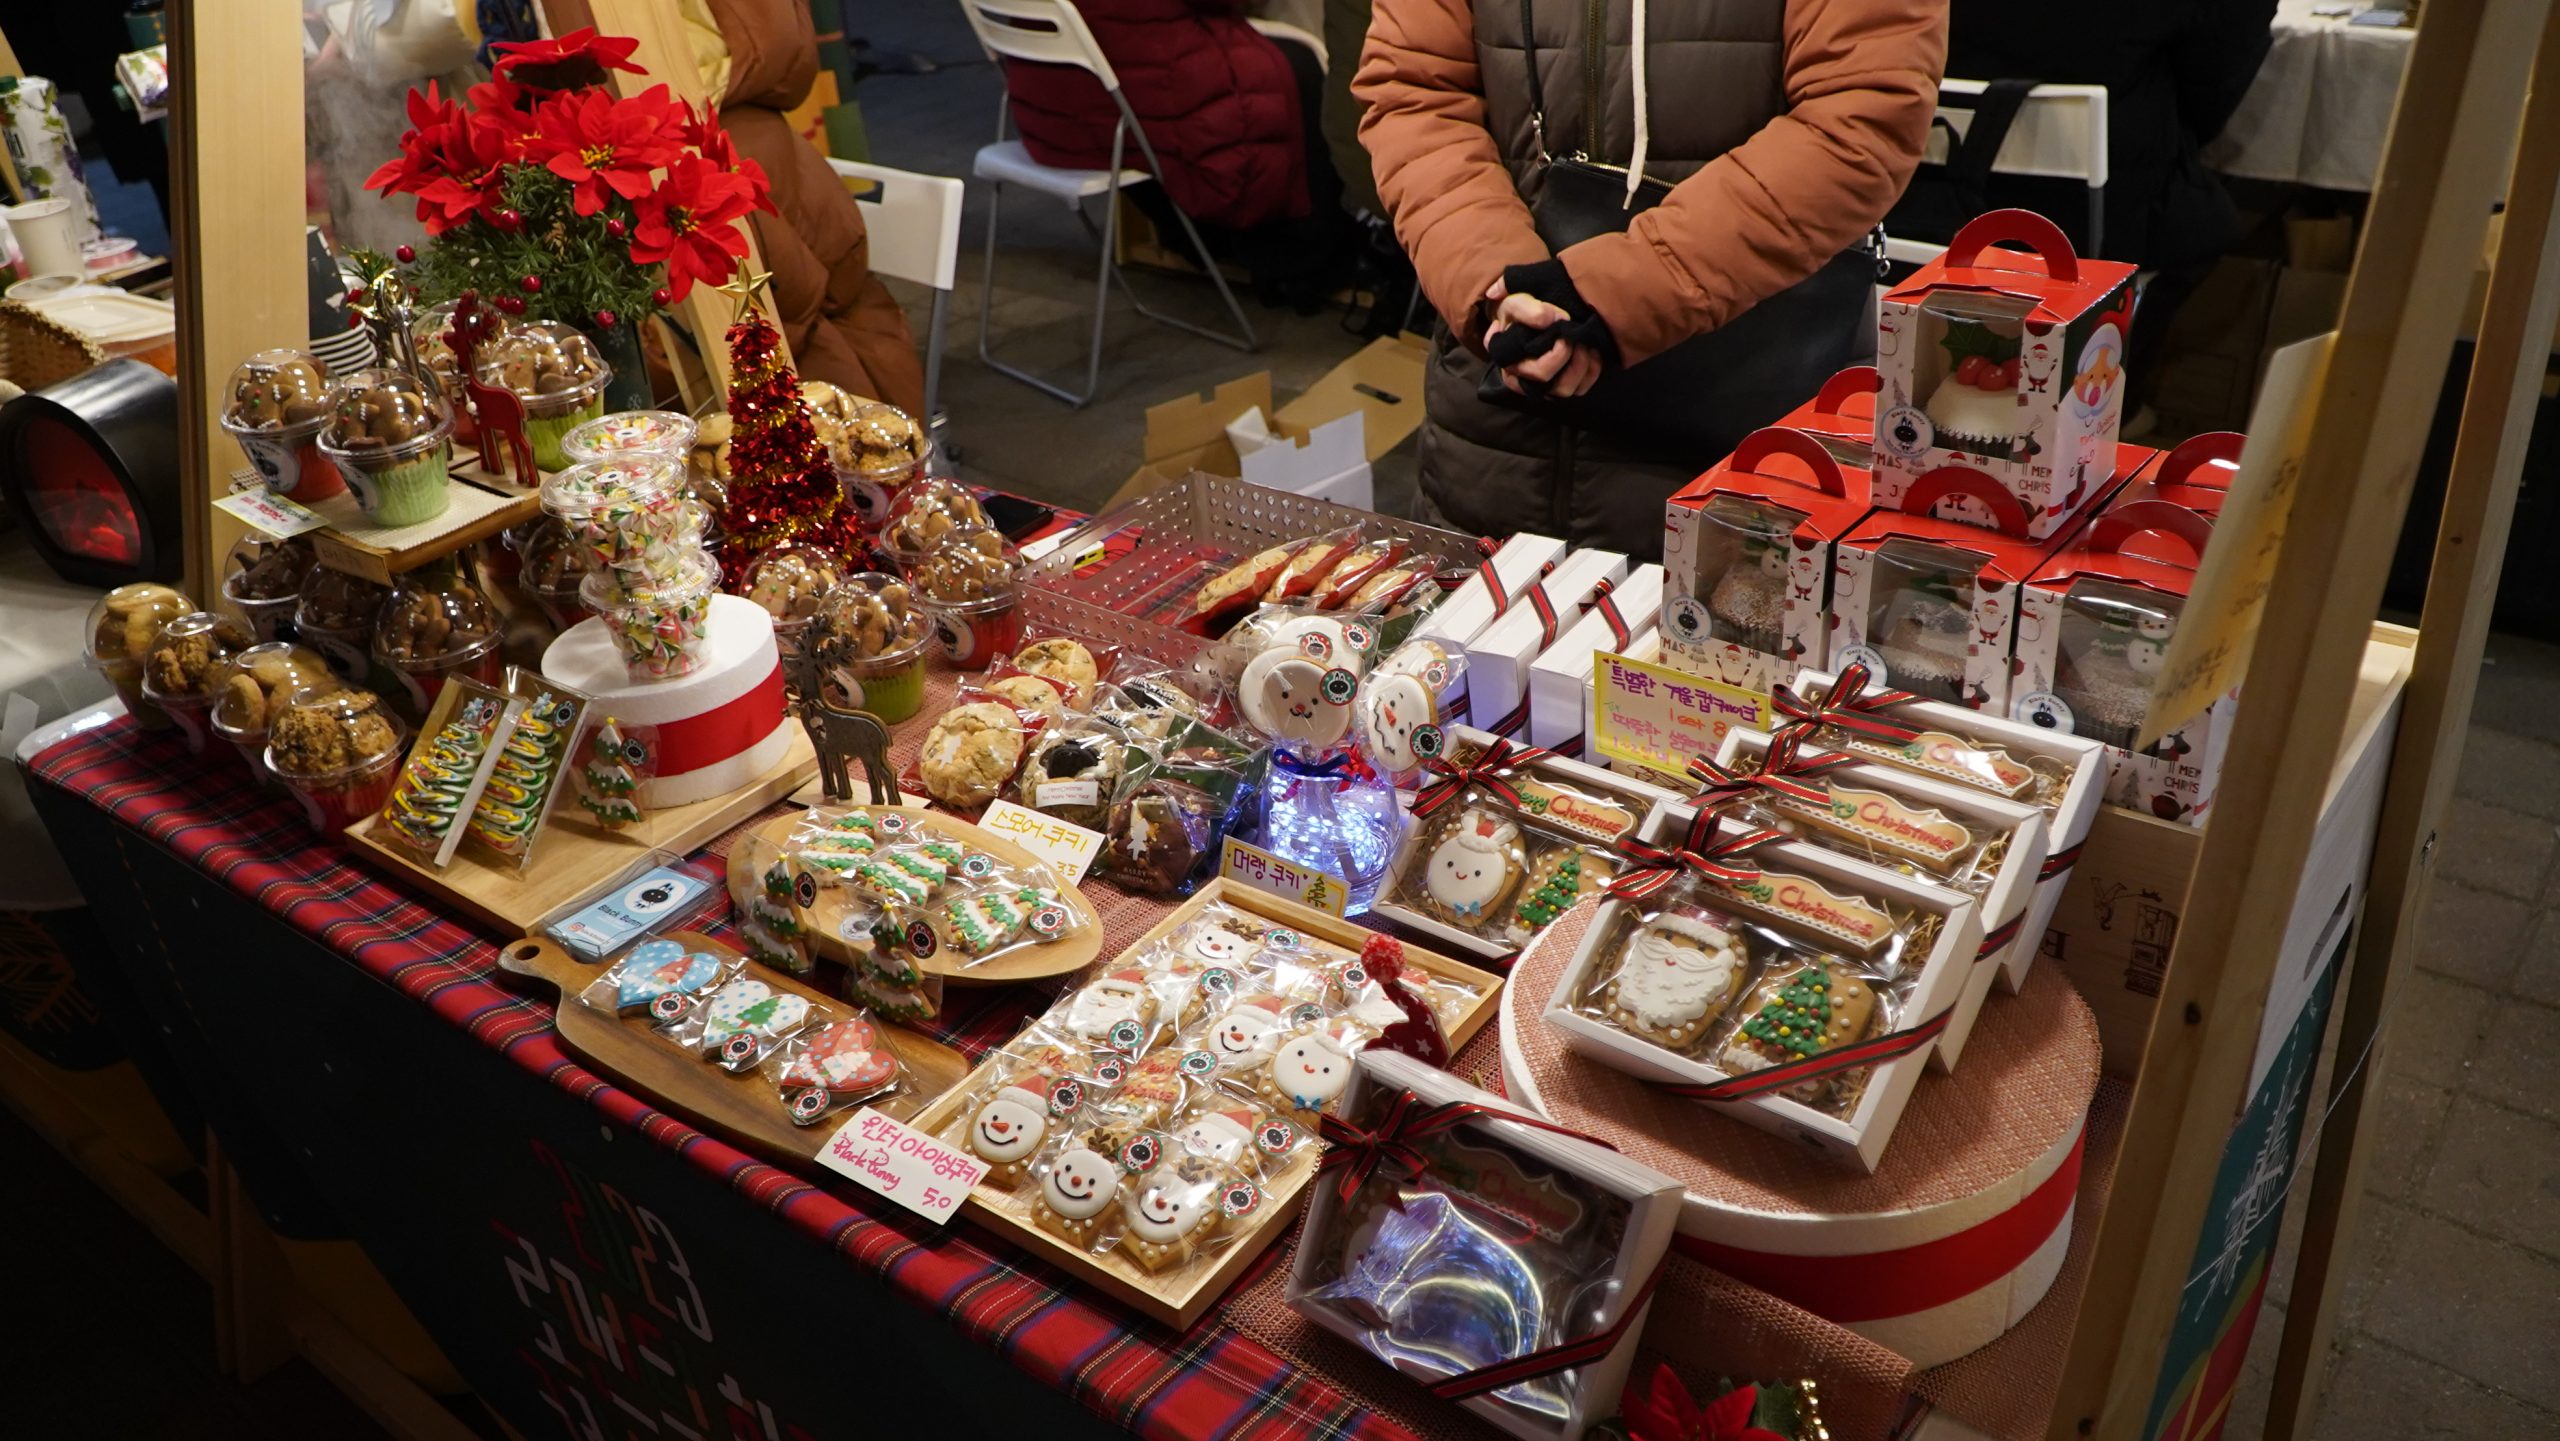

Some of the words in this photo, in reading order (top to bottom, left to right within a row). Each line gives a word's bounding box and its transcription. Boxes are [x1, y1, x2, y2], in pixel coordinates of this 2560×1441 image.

[1611, 664, 1657, 698] 특별한
[990, 808, 1044, 839] 스모어
[1042, 825, 1089, 853] 쿠키
[1549, 794, 1625, 835] Christmas
[1859, 801, 1954, 852] Christmas
[1232, 847, 1266, 881] 머랭
[1269, 863, 1300, 890] 쿠키
[598, 903, 620, 918] Black
[620, 914, 644, 928] Bunny
[1778, 885, 1874, 938] Christmas
[833, 1132, 867, 1169] Black
[867, 1148, 902, 1192] Bunny
[922, 1187, 952, 1209] 5.0
